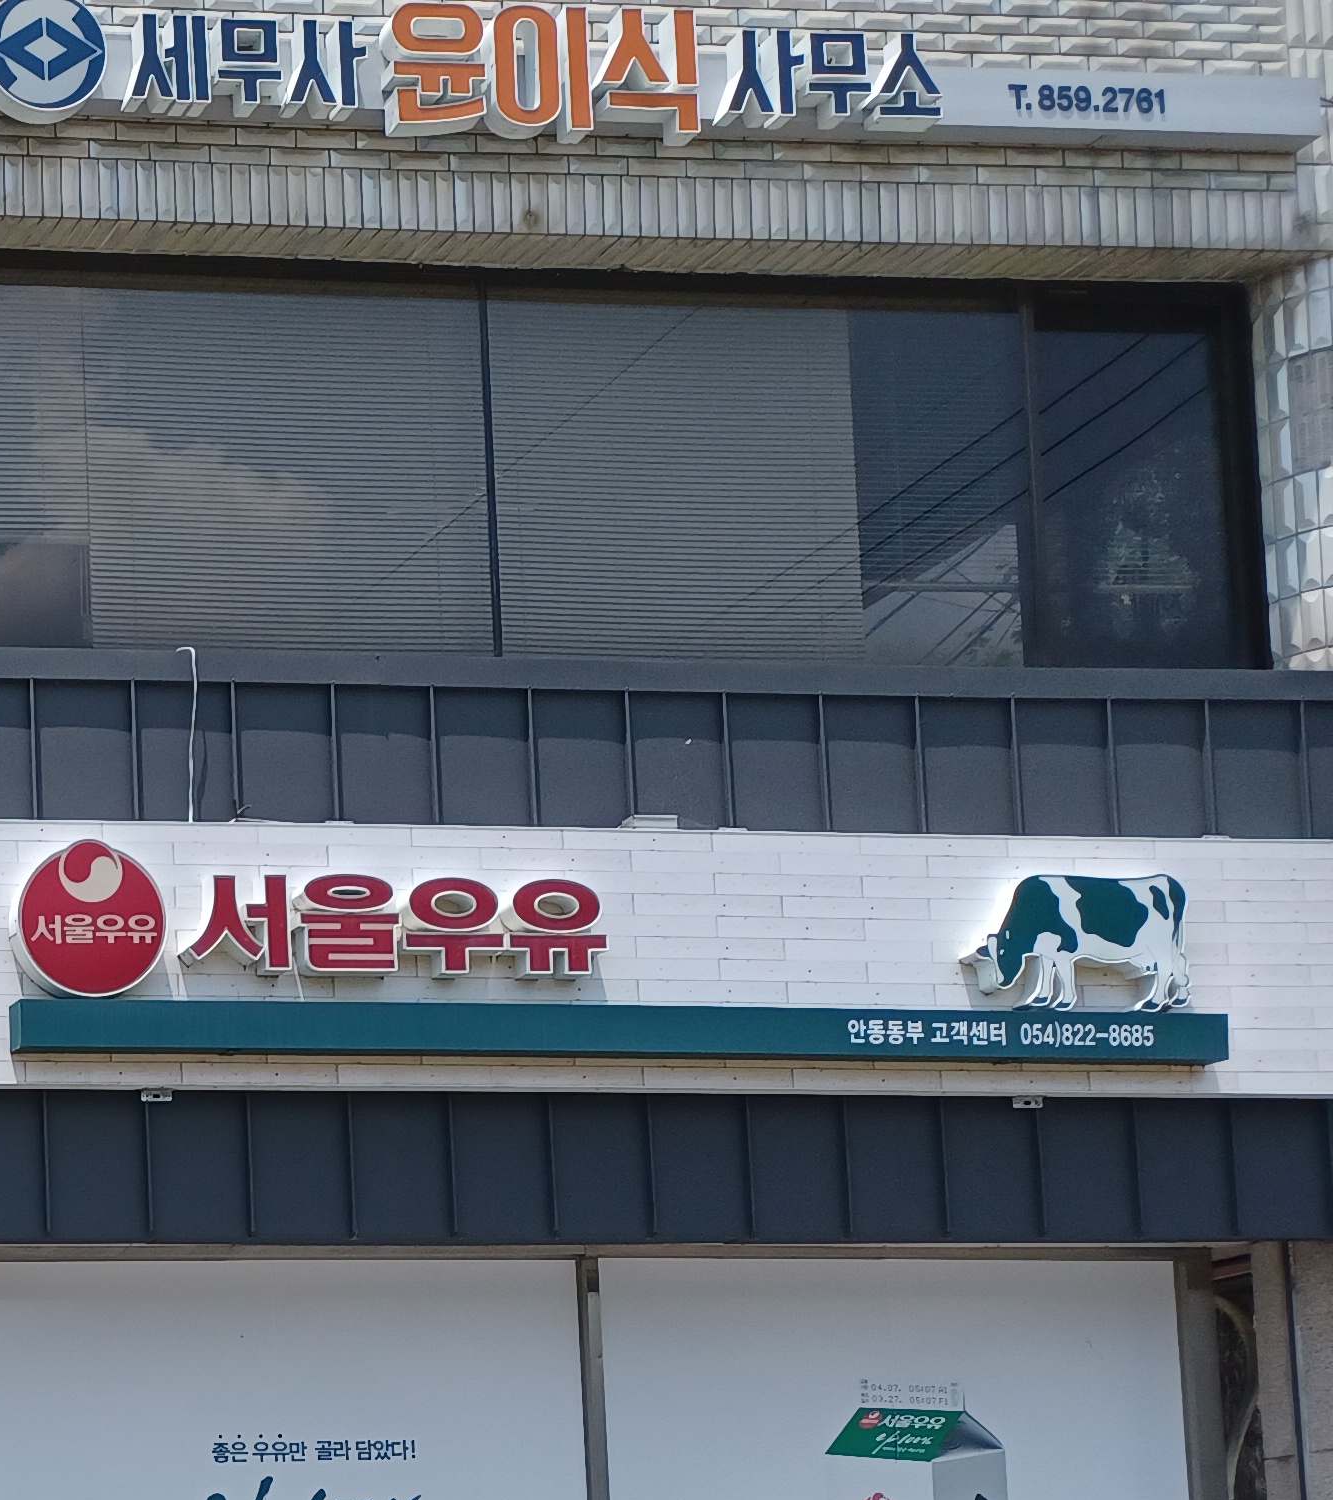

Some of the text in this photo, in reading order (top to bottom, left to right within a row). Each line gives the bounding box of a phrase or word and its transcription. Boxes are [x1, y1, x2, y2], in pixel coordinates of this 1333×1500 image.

[127, 13, 367, 112] 세무사
[383, 2, 701, 138] 윤이식
[723, 28, 944, 122] 사무소
[30, 913, 158, 945] 서울우유
[183, 873, 610, 976] 서울우유
[847, 1019, 1155, 1048] 안동동부 고객센터 054)822-8685
[314, 1439, 352, 1462] 골라
[355, 1439, 417, 1462] 담았다!
